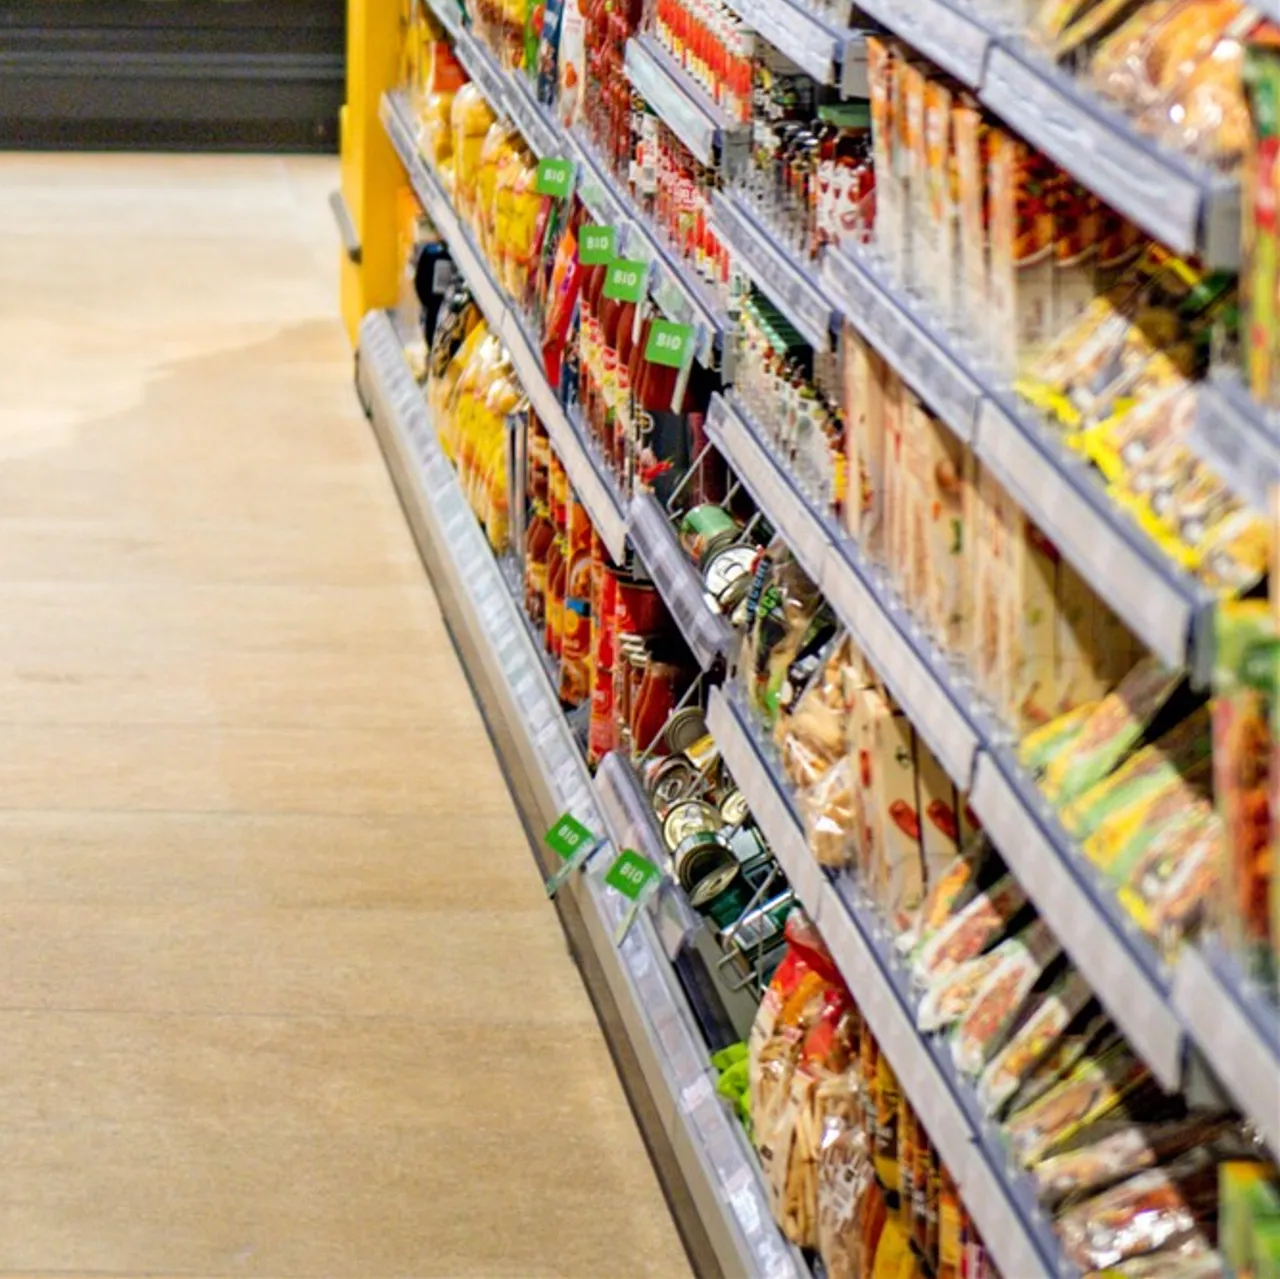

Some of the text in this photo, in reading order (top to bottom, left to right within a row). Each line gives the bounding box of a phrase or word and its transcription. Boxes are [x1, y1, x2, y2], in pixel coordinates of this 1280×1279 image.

[544, 169, 565, 183] BIO
[586, 238, 608, 250] BIO
[612, 270, 637, 286] BIO
[656, 332, 682, 351] BIO
[558, 825, 580, 846] BIO
[619, 862, 644, 885] BIO
